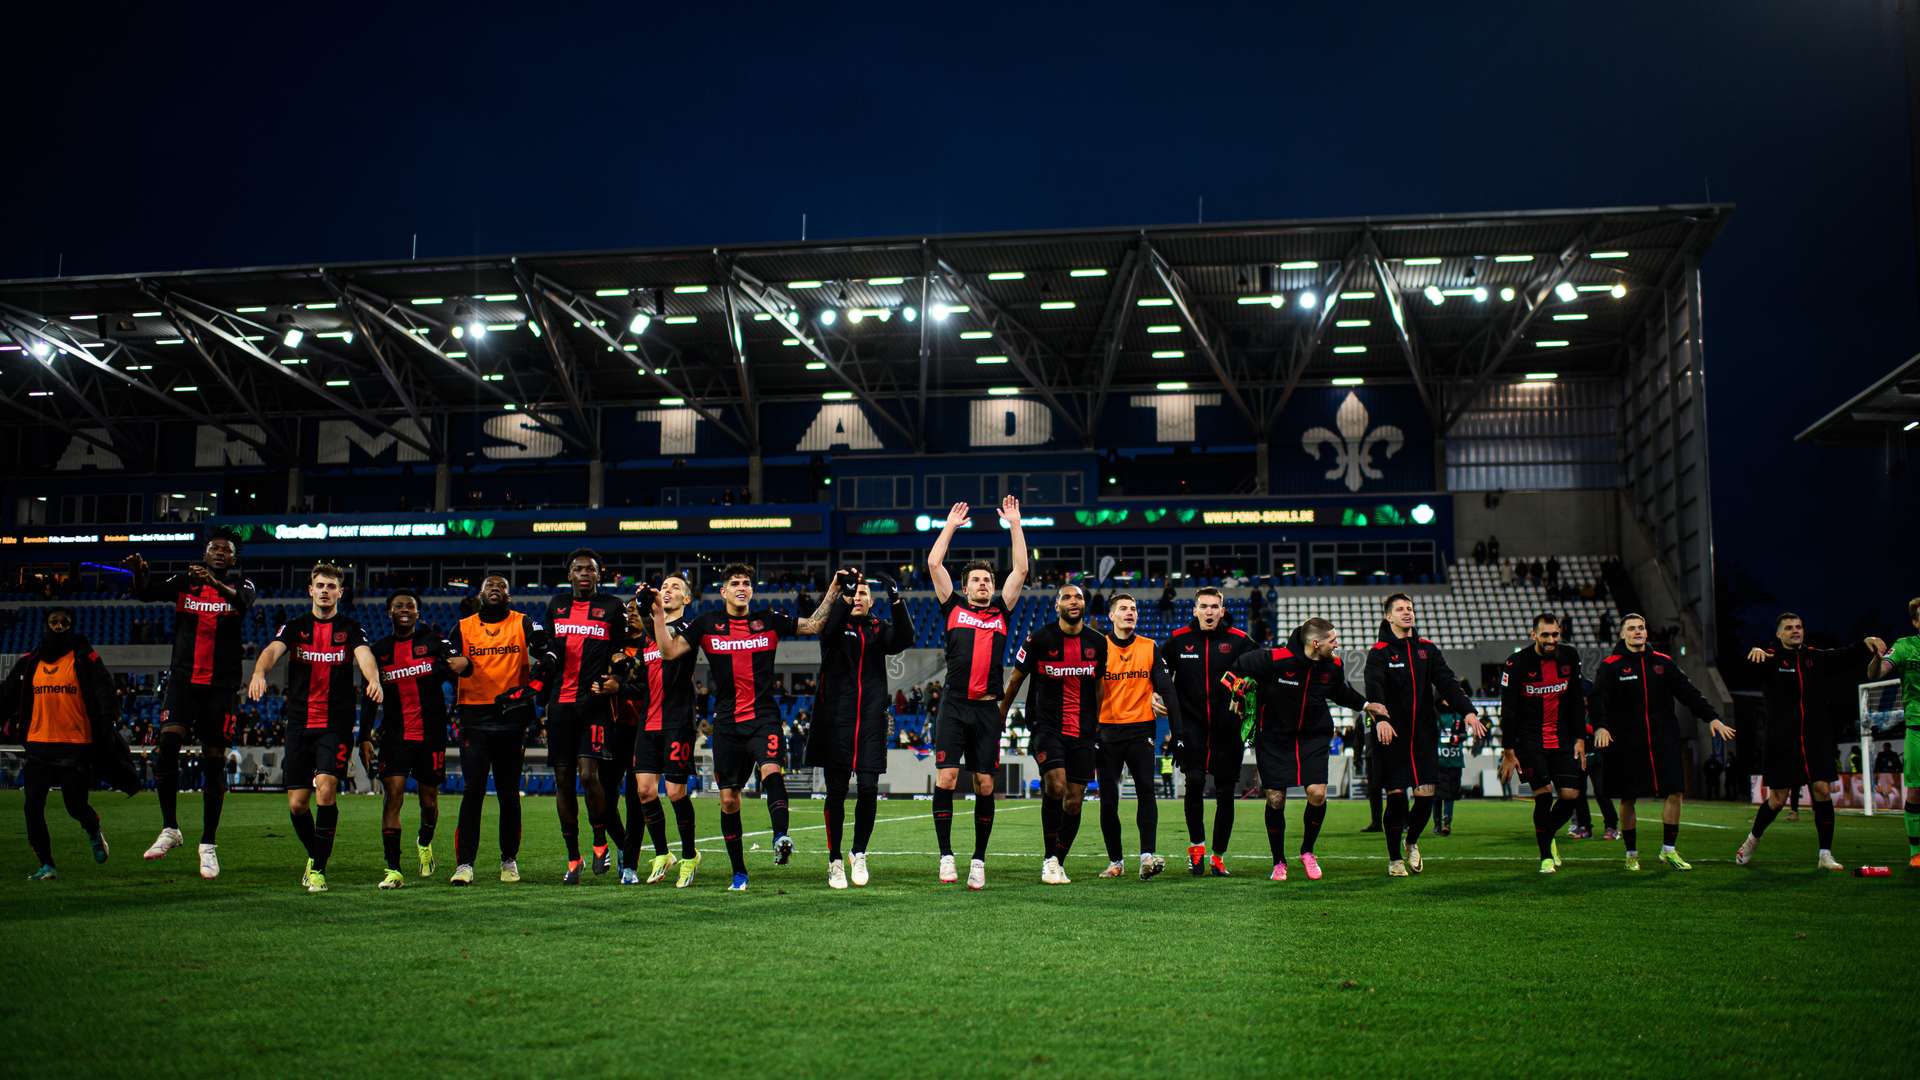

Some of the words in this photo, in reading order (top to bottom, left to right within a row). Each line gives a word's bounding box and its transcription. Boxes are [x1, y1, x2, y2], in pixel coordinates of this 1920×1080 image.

[329, 525, 359, 537] MACHT
[554, 623, 605, 637] Barmenia
[711, 636, 769, 650] Barmenia
[469, 644, 520, 656] Barmenia
[1104, 669, 1149, 681] Barmenia
[33, 684, 78, 695] armenia
[767, 734, 779, 750] 3
[336, 743, 347, 762] 2
[670, 741, 690, 761] 20
[1438, 747, 1460, 758] OST
